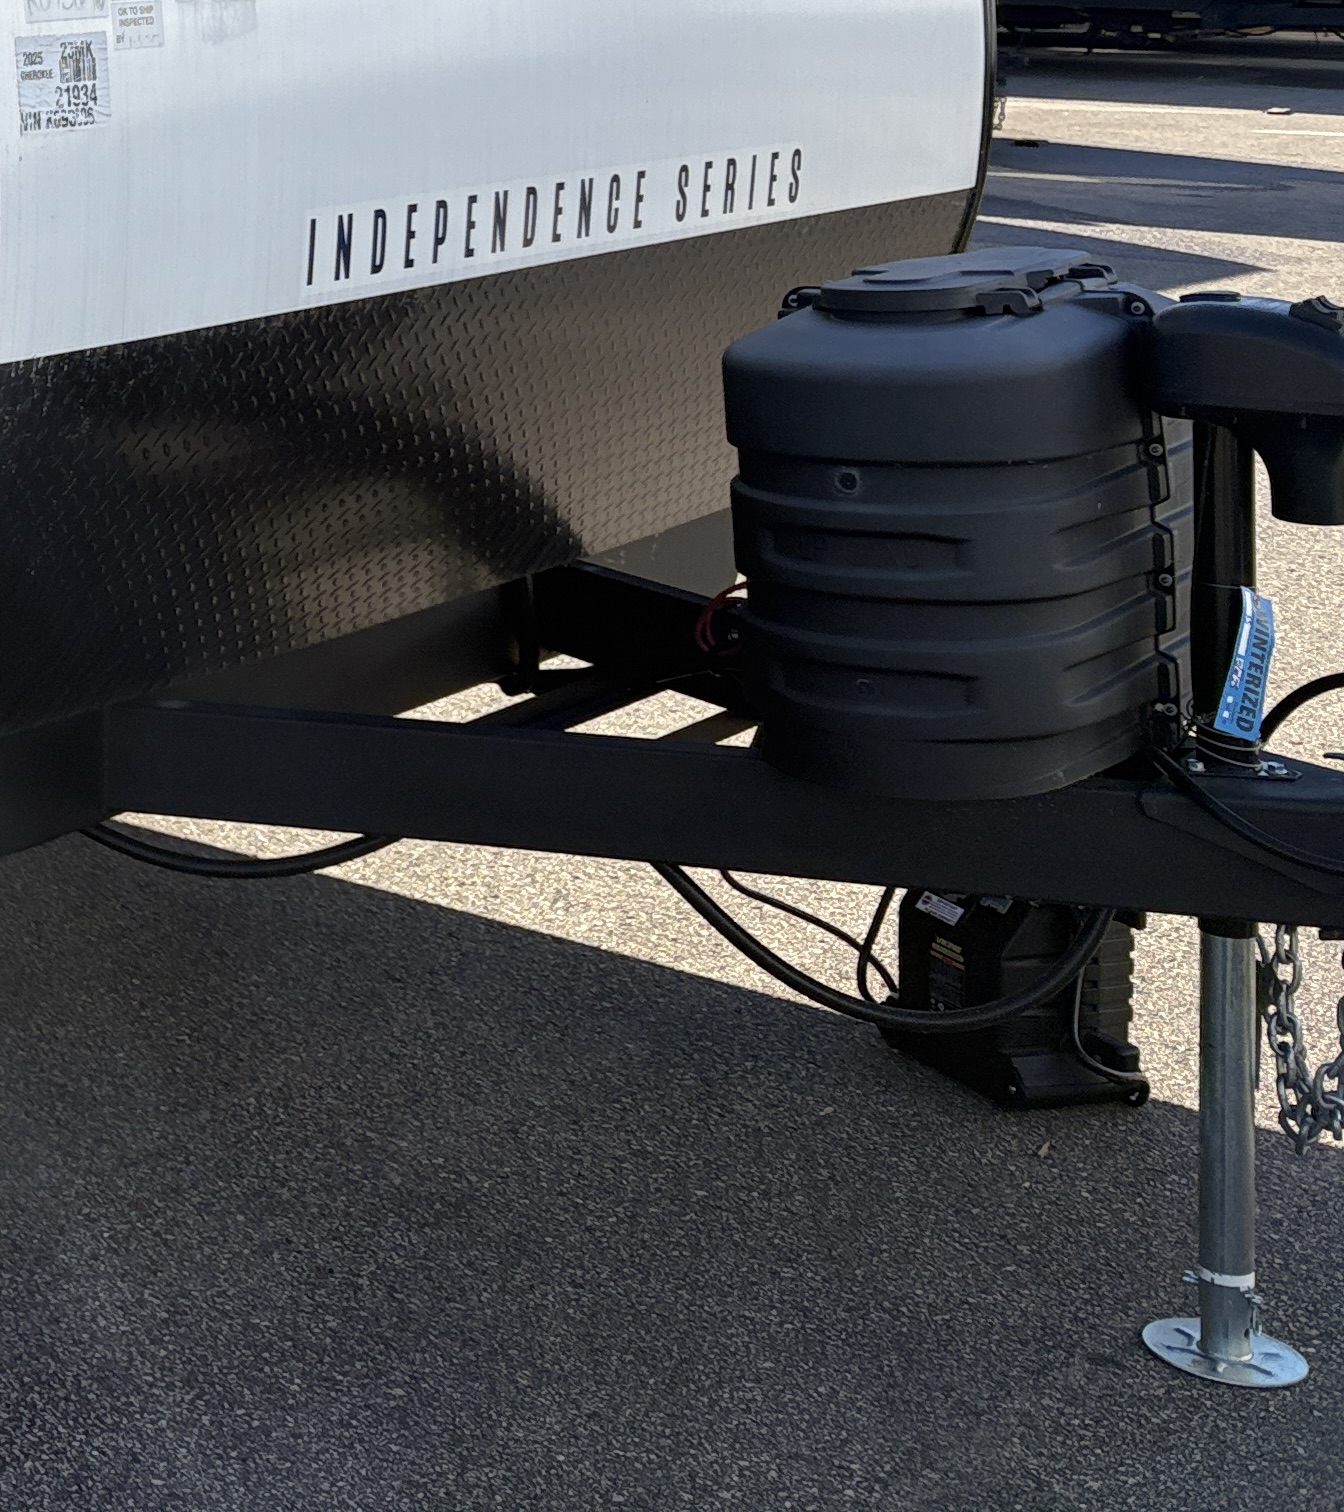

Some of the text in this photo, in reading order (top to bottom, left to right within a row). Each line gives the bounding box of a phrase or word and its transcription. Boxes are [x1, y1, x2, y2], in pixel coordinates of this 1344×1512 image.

[306, 148, 803, 286] INDEPENDENCE SERIES
[1235, 610, 1271, 734] WINTERIZED
